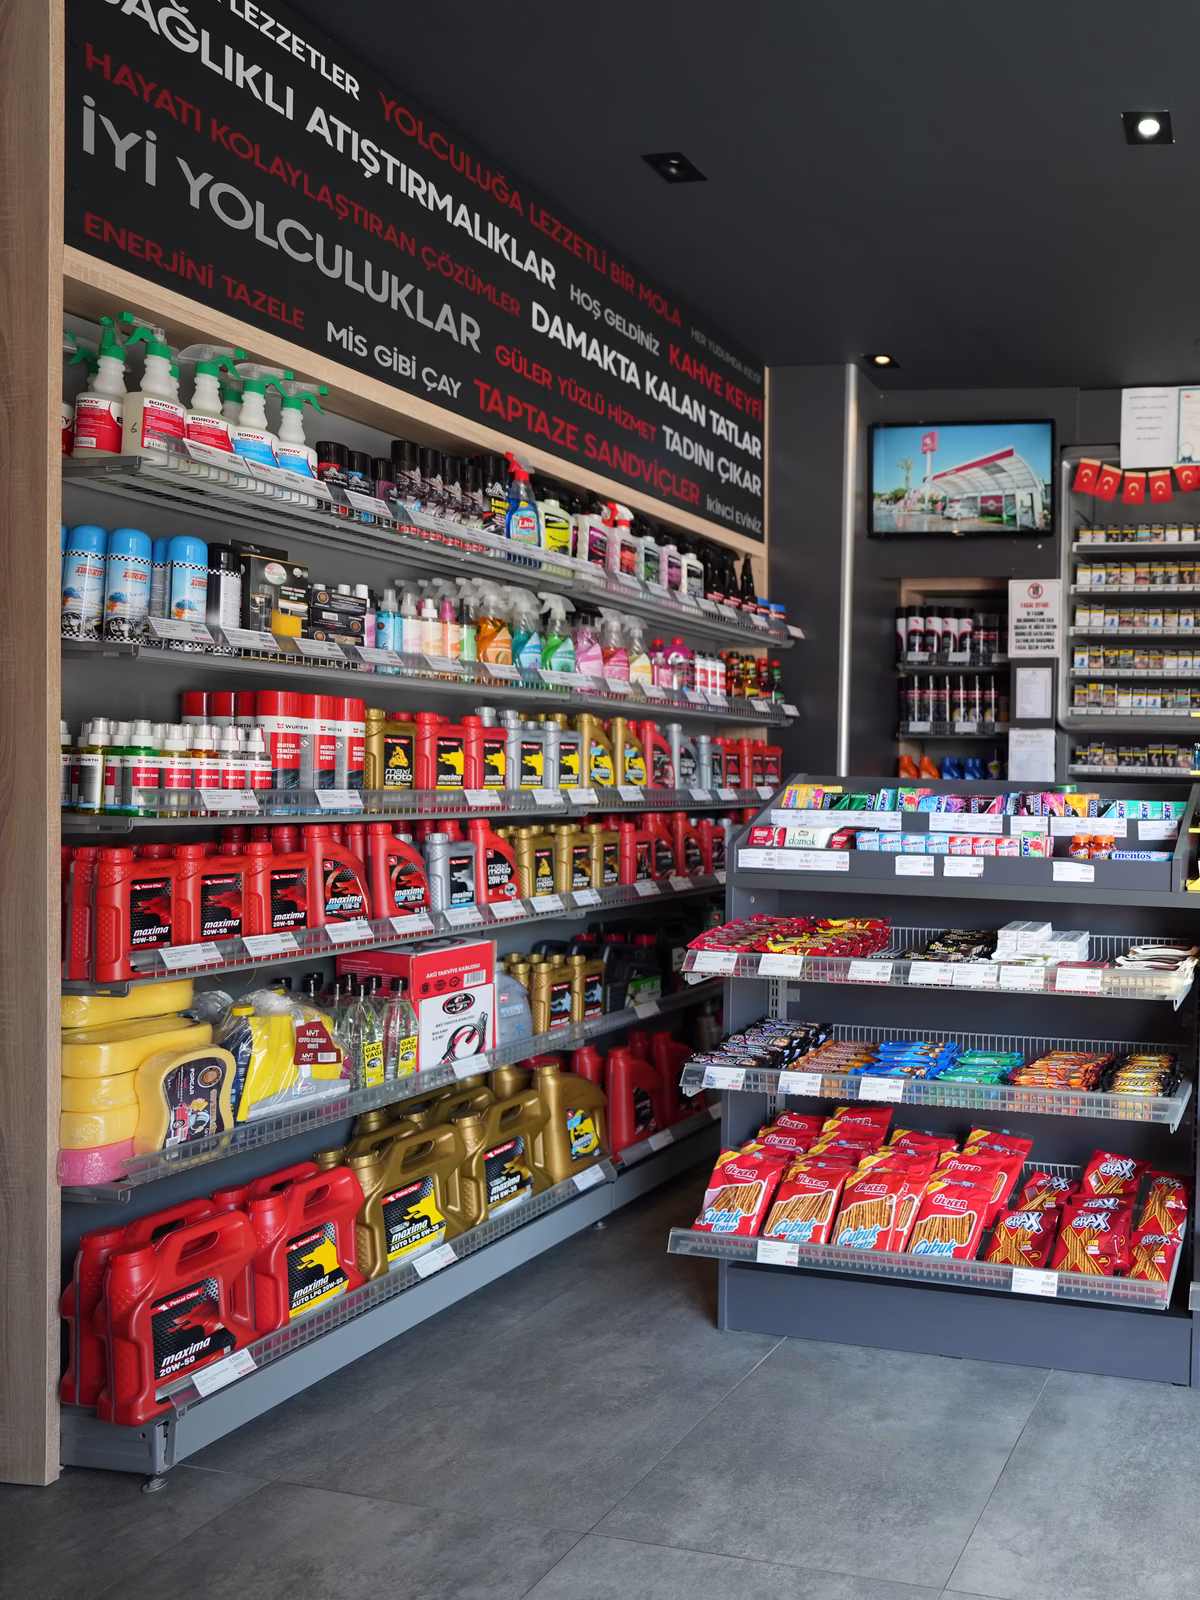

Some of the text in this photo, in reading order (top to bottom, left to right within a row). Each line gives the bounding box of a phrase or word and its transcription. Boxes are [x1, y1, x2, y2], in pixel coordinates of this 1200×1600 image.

[104, 0, 557, 291] AĞLIKLI ATIŞTIRMALIKLAR
[85, 42, 521, 319] HAYATI KOLAYLAŞTIRAN ÇÖZÜMLER
[378, 90, 682, 328] YOLCULUĞA LEZZETLİ BİR MOLA
[82, 94, 482, 355] İYİ YOLCULUKLAR
[84, 211, 305, 331] ENERJİNİ TAZELE
[570, 283, 660, 357] HOŞ GELDİNİZ
[326, 320, 462, 399] MİS GİBİ ÇAY
[668, 342, 723, 398] KAHVE
[531, 300, 762, 460] DAMAKTA KALAN TATLAR
[494, 343, 657, 442] GÜLER YÜZLÜ HİZMET
[149, 400, 179, 411] BOROXY
[130, 422, 138, 434] 6
[473, 377, 701, 507] TAPTAZE SANDVİÇLER
[662, 424, 762, 497] TADINI ÇIKAR
[706, 493, 762, 535] İKİNCİ EVİNİZ
[788, 833, 816, 846] damak
[1114, 851, 1152, 860] mentos
[204, 918, 240, 929] maxima
[272, 919, 295, 928] 20W-50
[273, 911, 305, 922] maxima
[132, 935, 157, 944] 20W-50
[133, 925, 169, 937] maxima
[202, 928, 228, 936] 20W-50
[425, 971, 438, 979] AKÜ
[365, 1044, 381, 1053] GAZ
[401, 1038, 416, 1047] GAZ
[725, 1163, 757, 1179] ÜLKER
[1100, 1159, 1137, 1181] CRAX
[933, 1193, 968, 1208] ÜLKER
[703, 1208, 744, 1225] Çubuk
[712, 1222, 738, 1233] Kraker
[773, 1217, 816, 1235] Çubuk
[1005, 1211, 1044, 1234] CRAX
[1072, 1211, 1111, 1233] CRAX
[390, 1224, 440, 1253] AUTO LPG 5W-30
[392, 1219, 428, 1243] maxima
[837, 1225, 880, 1246] Çubuk
[169, 1290, 199, 1307] Petrol Ofisi
[292, 1276, 344, 1309] AUTO LPG 20W-50
[293, 1275, 329, 1300] maxima
[161, 1336, 211, 1368] maxima
[159, 1355, 196, 1378] 20W-50
